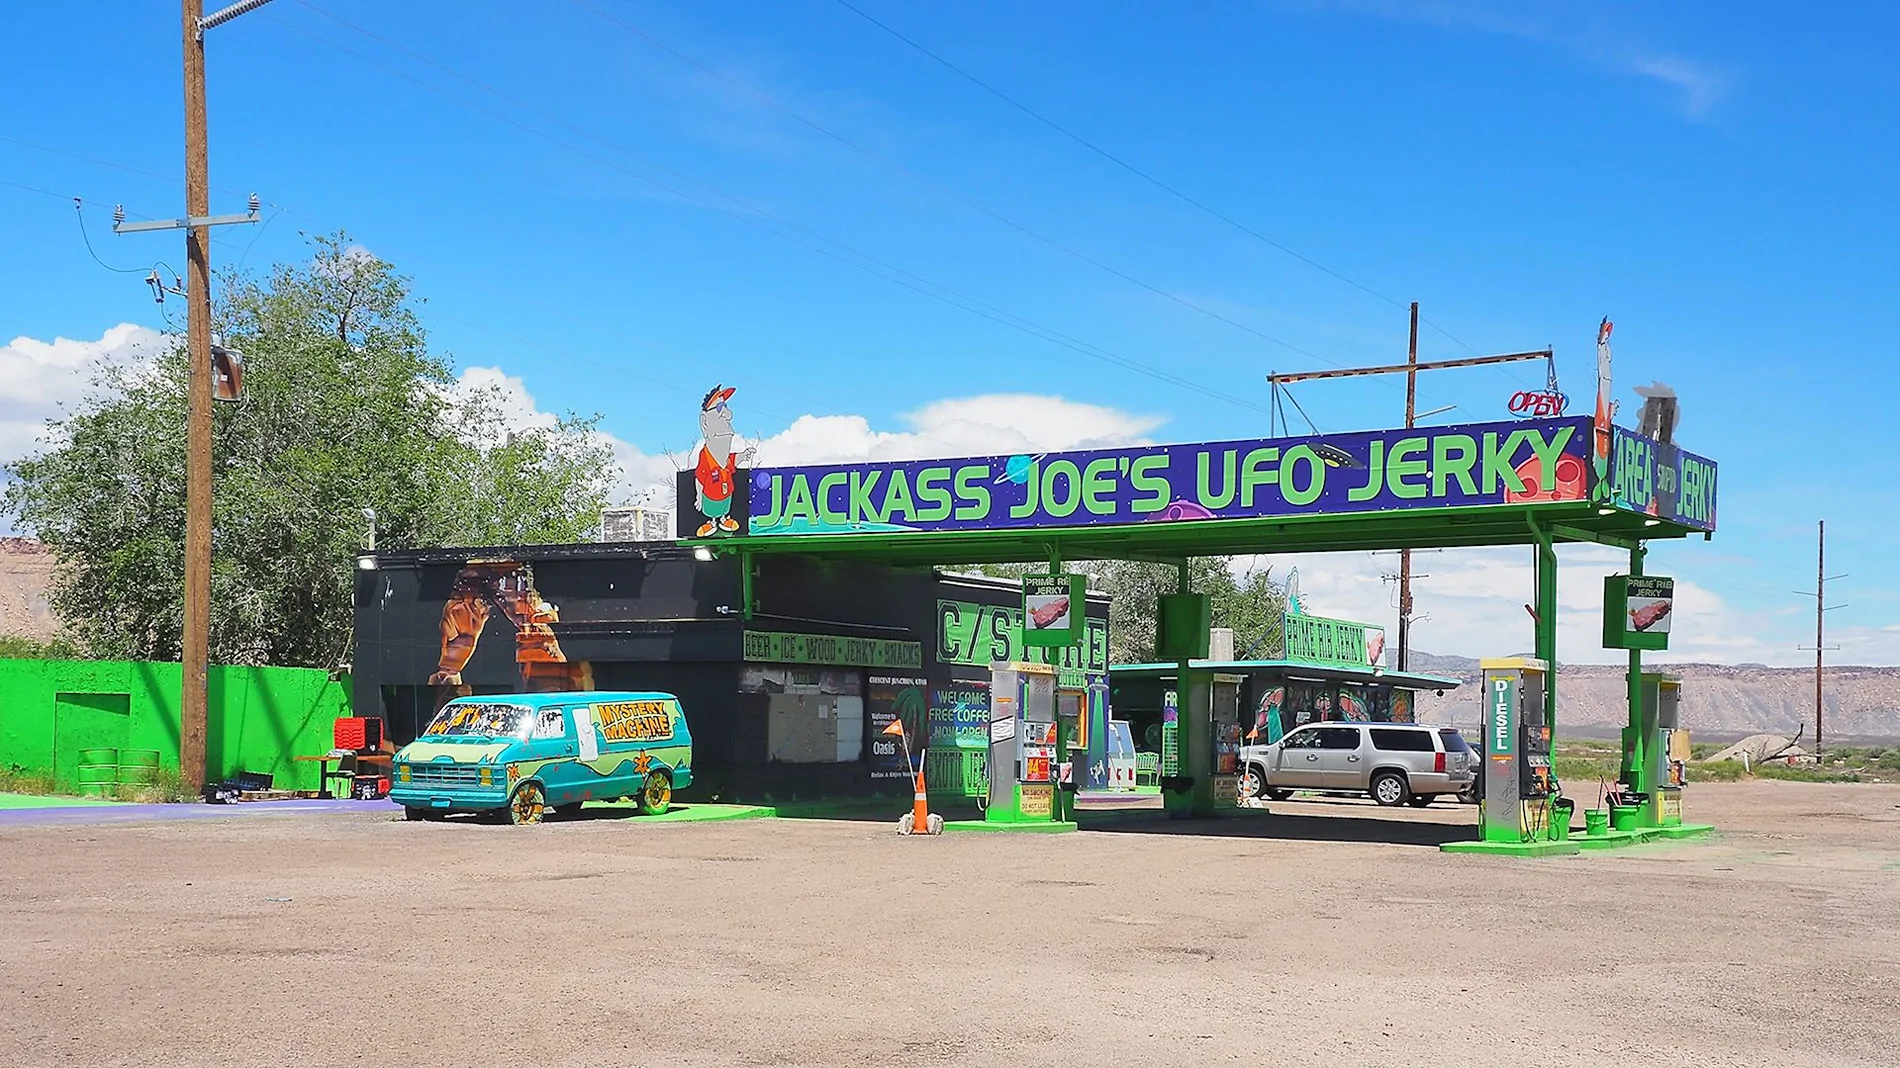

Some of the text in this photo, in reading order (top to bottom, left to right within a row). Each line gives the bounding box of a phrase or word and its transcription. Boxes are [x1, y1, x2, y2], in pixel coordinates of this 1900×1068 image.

[1509, 391, 1564, 416] OPEN
[756, 426, 1576, 527] JACKASS JOE'S UFO JERKY
[1613, 436, 1653, 506] AREA
[1676, 456, 1716, 523] JERKY
[1025, 578, 1054, 586] PRIME
[1035, 586, 1064, 595] JERKY
[1628, 579, 1673, 589] PRIME RIB
[1635, 588, 1662, 597] JERKY
[745, 633, 920, 666] BEER ICE WOOD JERKY SNACKS
[1286, 618, 1364, 663] PRIME RIB JERKY
[937, 690, 986, 705] WELCOME
[597, 702, 665, 727] MYSTERY
[928, 707, 990, 723] FREE COFFE
[1495, 680, 1508, 750] DIESEL
[604, 716, 670, 740] MACHINE
[961, 725, 988, 740] OPEN
[873, 741, 896, 755] Oasis
